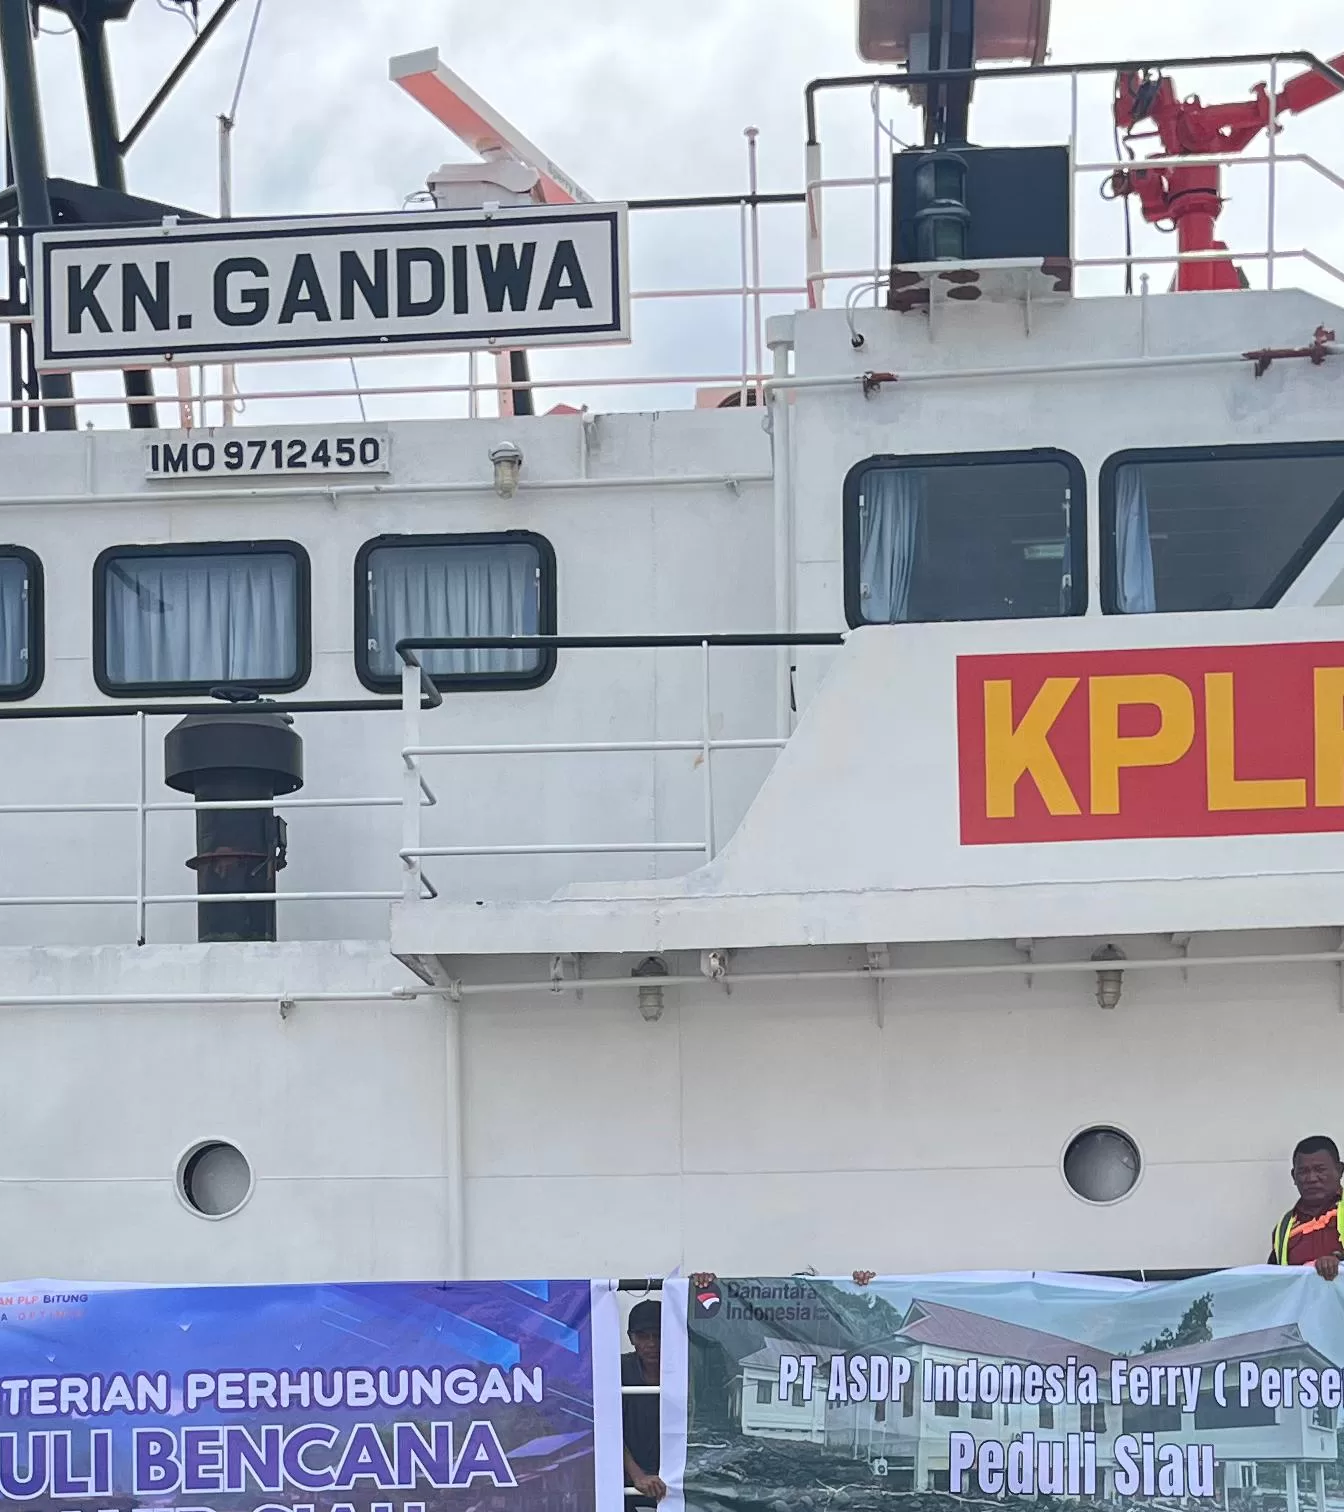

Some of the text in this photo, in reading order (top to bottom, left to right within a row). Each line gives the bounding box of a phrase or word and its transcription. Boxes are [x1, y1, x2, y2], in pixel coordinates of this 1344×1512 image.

[67, 240, 593, 334] KN. GANDIWA
[151, 437, 380, 474] IMO 9712450
[727, 1282, 817, 1300] Danantara
[727, 1302, 811, 1321] Indonesia
[187, 1366, 544, 1410] PERHUBUNGAN
[777, 1356, 814, 1402] PT
[827, 1354, 911, 1404] ASDP
[923, 1354, 1101, 1407] Indonesia
[1109, 1360, 1202, 1416] Ferry
[132, 1420, 519, 1495] BENCANA
[949, 1430, 1216, 1500] Peduli Siau
